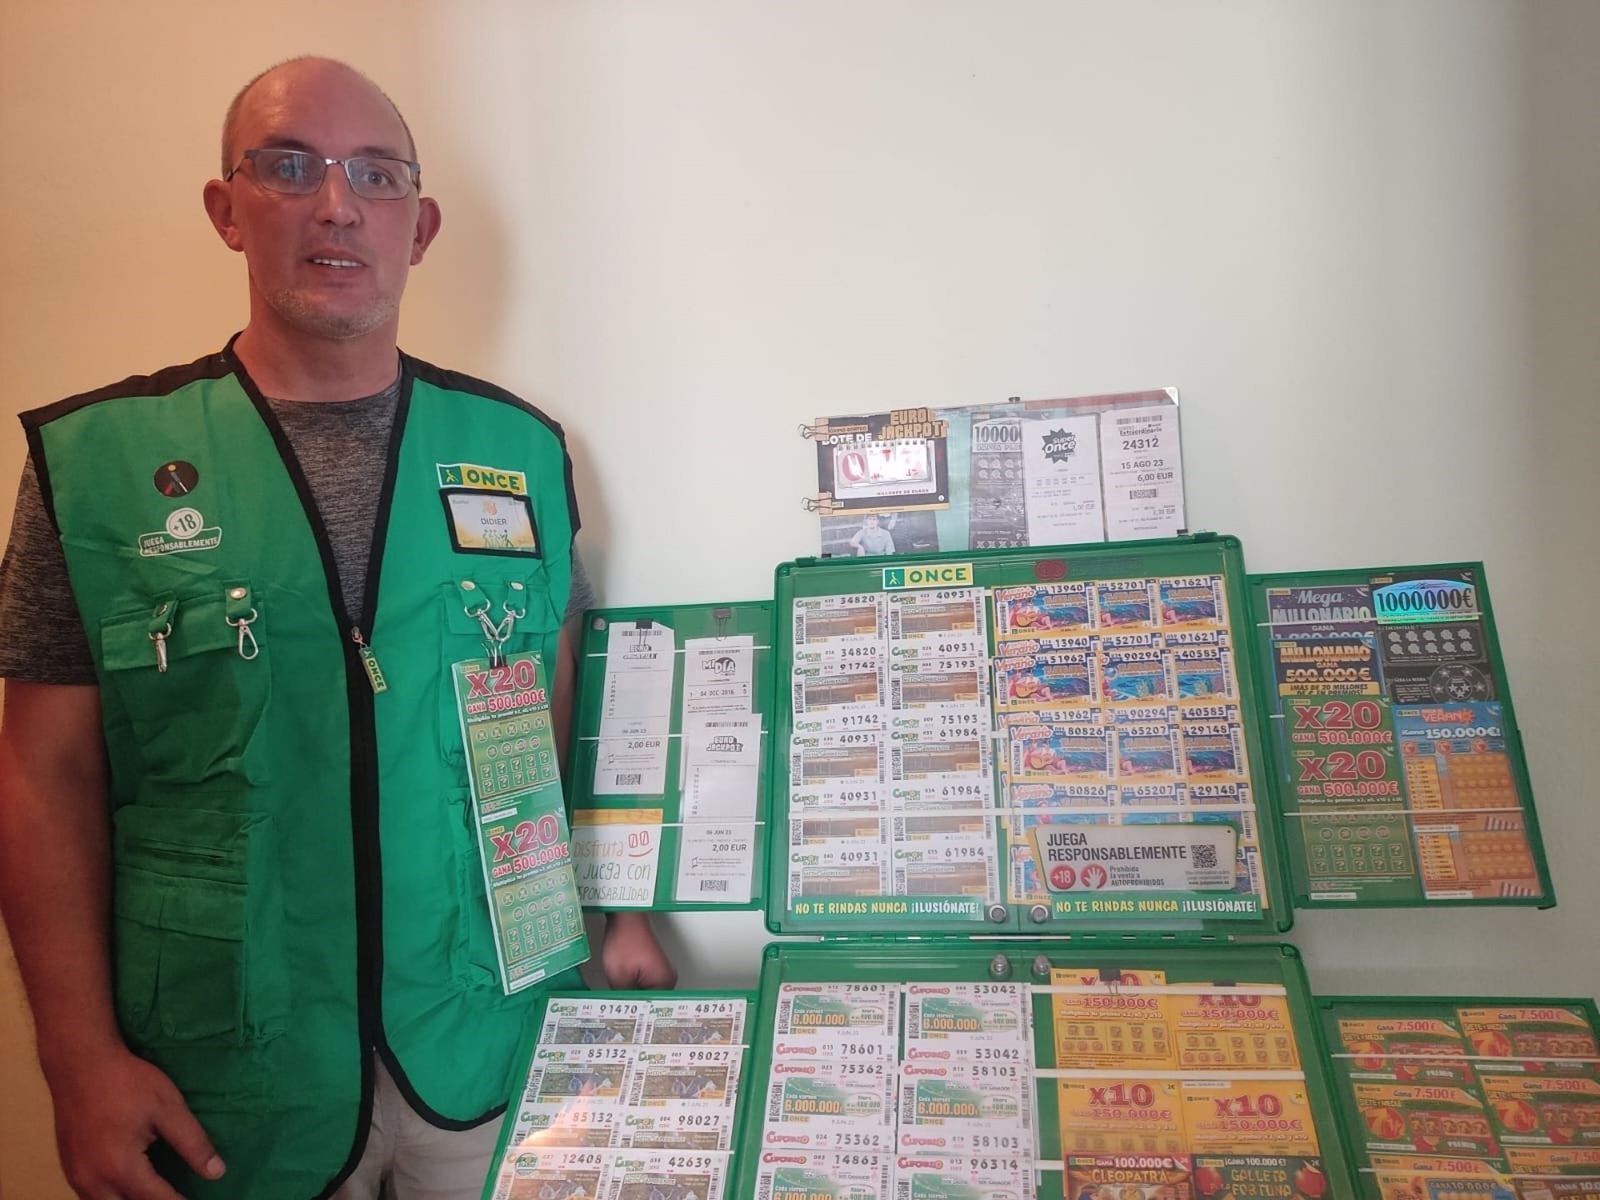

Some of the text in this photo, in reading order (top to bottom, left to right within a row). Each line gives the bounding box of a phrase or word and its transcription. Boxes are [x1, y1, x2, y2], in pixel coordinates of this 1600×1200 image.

[1044, 440, 1077, 454] Once
[1122, 438, 1159, 451] 24312
[1121, 459, 1164, 470] 15 AGO 23
[466, 469, 520, 490] ONCE
[1137, 473, 1155, 483] 6,00
[1156, 472, 1174, 480] EUR
[173, 513, 197, 532] +18
[144, 536, 165, 547] JUEGA
[144, 536, 218, 554] RESPONSABLEMENTE
[909, 567, 967, 583] ONCE
[1110, 581, 1144, 590] 52701
[1174, 578, 1209, 586] 91621
[1050, 583, 1083, 593] 13940
[840, 595, 875, 605] 34820
[936, 590, 972, 599] 40931
[1297, 590, 1342, 608] Mega
[1272, 606, 1371, 623] MILLONARIO
[1115, 635, 1149, 645] 52701
[1180, 632, 1215, 641] 91621
[938, 643, 975, 653] 40931
[1055, 638, 1088, 647] 13940
[841, 647, 876, 657] 34820
[1124, 651, 1160, 660] 90294
[1182, 649, 1218, 659] 40585
[1280, 645, 1371, 663] MILLONARIO
[1050, 654, 1085, 663] 51962
[840, 662, 875, 670] 91742
[939, 660, 976, 669] 75193
[368, 659, 385, 688] ONCE
[465, 659, 535, 699] x20
[467, 690, 545, 713] GANA 500.000€
[1054, 710, 1089, 720] 51962
[1130, 709, 1166, 718] 90294
[1188, 706, 1225, 716] 40585
[1294, 700, 1381, 729] x20
[842, 714, 879, 726] 91742
[940, 714, 978, 725] 75193
[939, 728, 978, 737] 61984
[1011, 728, 1052, 740] Verano
[1067, 727, 1103, 736] 80826
[1130, 726, 1169, 735] 65207
[1189, 725, 1227, 735] 29148
[840, 734, 876, 743] 40931
[1293, 731, 1392, 745] GANA 500.000€
[628, 741, 644, 750] 2,00
[1298, 750, 1386, 781] x20
[942, 786, 981, 796] 61984
[1069, 786, 1105, 795] 80826
[1137, 786, 1175, 795] 65207
[1197, 786, 1236, 795] 29148
[1297, 781, 1399, 796] GANA 500.000€
[840, 791, 877, 801] 40931
[490, 815, 559, 862] x20
[1047, 833, 1088, 846] JUEGA
[712, 843, 747, 853] 2,00 EUR
[945, 847, 985, 857] 61984
[1048, 845, 1187, 862] RESPONSABLEMENTE
[492, 843, 568, 877] GANA 500.000€
[840, 852, 878, 862] 40931
[1052, 870, 1071, 884] +18
[795, 900, 979, 914] NO TE RINDAS NUNCA ¡ILUSIÓNATE!
[1056, 899, 1257, 914] NO TE RINDAS NUNCA ¡ILUSIÓNATE!
[845, 984, 886, 993] 78601
[974, 985, 1016, 994] 53042
[599, 1004, 638, 1015] 91470
[695, 1003, 733, 1013] 48761
[587, 1049, 627, 1058] 85132
[841, 1044, 883, 1055] 78601
[975, 1048, 1019, 1059] 53042
[689, 1051, 729, 1061] 98027
[841, 1065, 883, 1075] 75362
[972, 1066, 1017, 1077] 58103
[1089, 1084, 1155, 1108] x10
[1393, 1090, 1412, 1098] Gana
[1214, 1094, 1283, 1118] x10
[572, 1112, 613, 1123] 85132
[678, 1115, 720, 1126] 98027
[835, 1133, 880, 1146] 75362
[972, 1136, 1019, 1149] 58103
[562, 1154, 602, 1164] 12408
[668, 1157, 712, 1168] 42639
[835, 1154, 879, 1166] 14863
[970, 1158, 1018, 1171] 96314
[1114, 1157, 1173, 1168] 100.000€
[1413, 1163, 1433, 1171] Gana
[1092, 1168, 1169, 1184] CLEOPATRA
[1231, 1169, 1287, 1182] GALLETA
